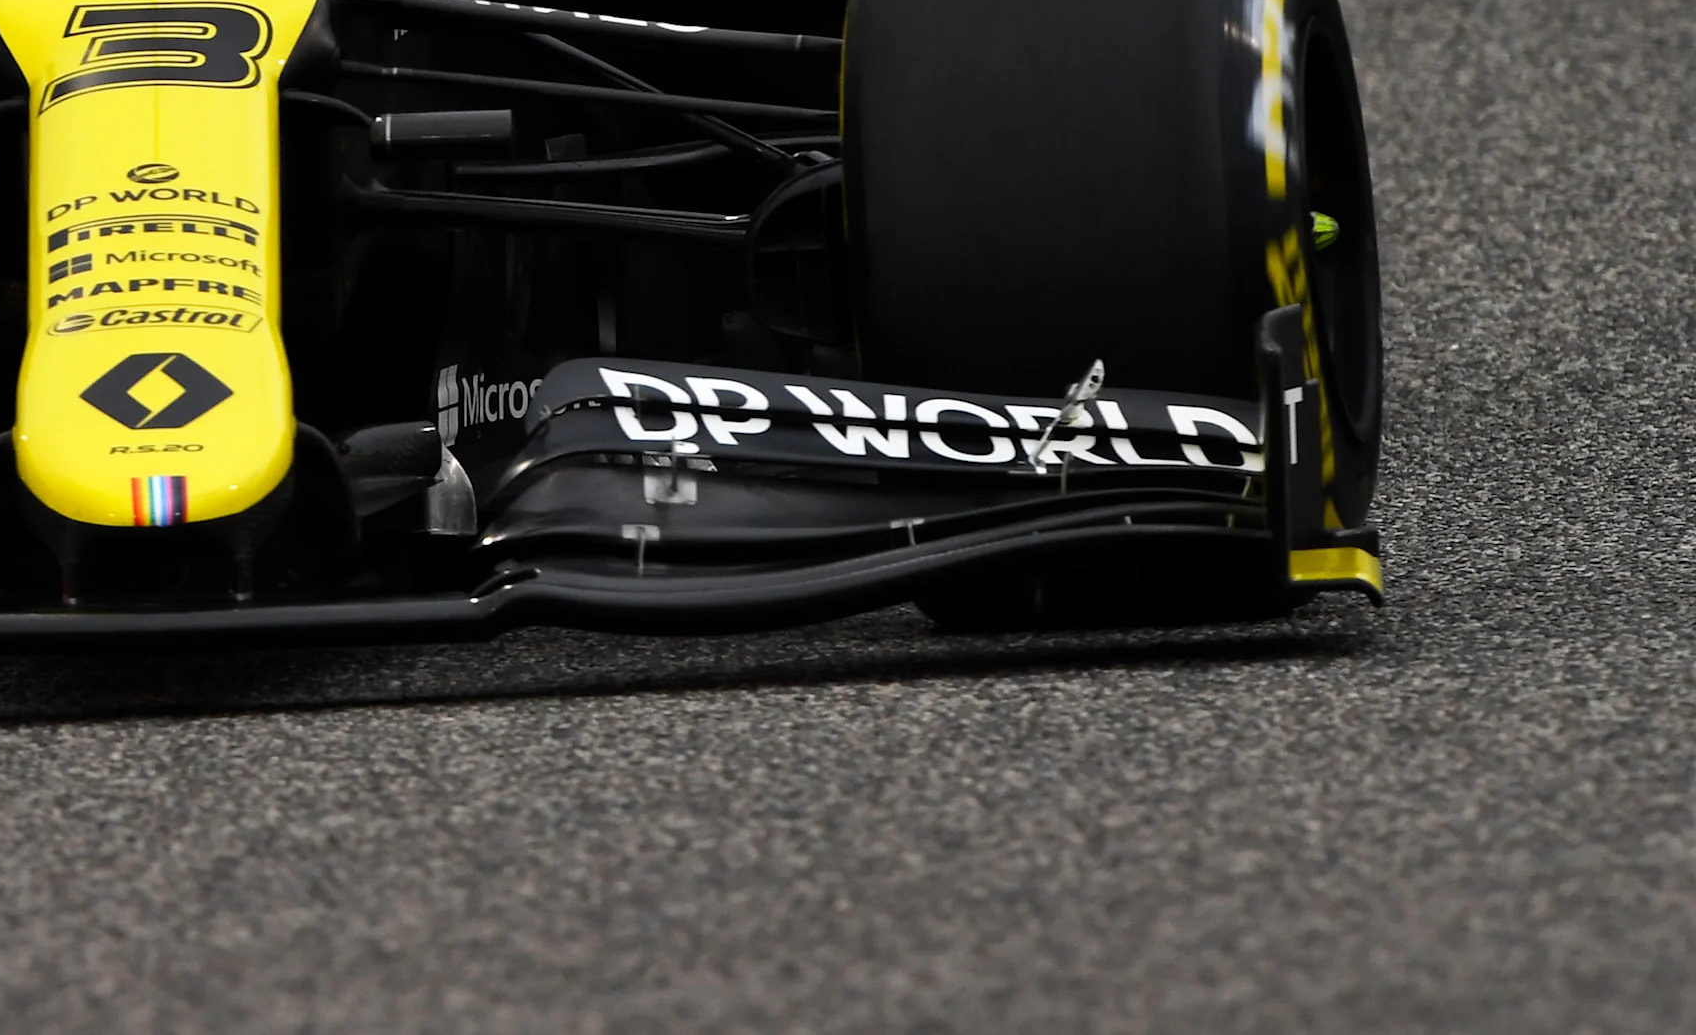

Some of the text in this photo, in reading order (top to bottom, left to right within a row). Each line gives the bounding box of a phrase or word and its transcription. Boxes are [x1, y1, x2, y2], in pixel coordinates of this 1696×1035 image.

[37, 1, 273, 117] 3
[47, 188, 261, 222] DP WORLD
[47, 213, 261, 254] PIRELLI
[105, 250, 263, 278] Microsoft
[47, 278, 263, 310] MAPFRE
[100, 307, 245, 329] Castrol
[599, 367, 1265, 473] DP WORLD
[109, 443, 205, 455] R.S.20
